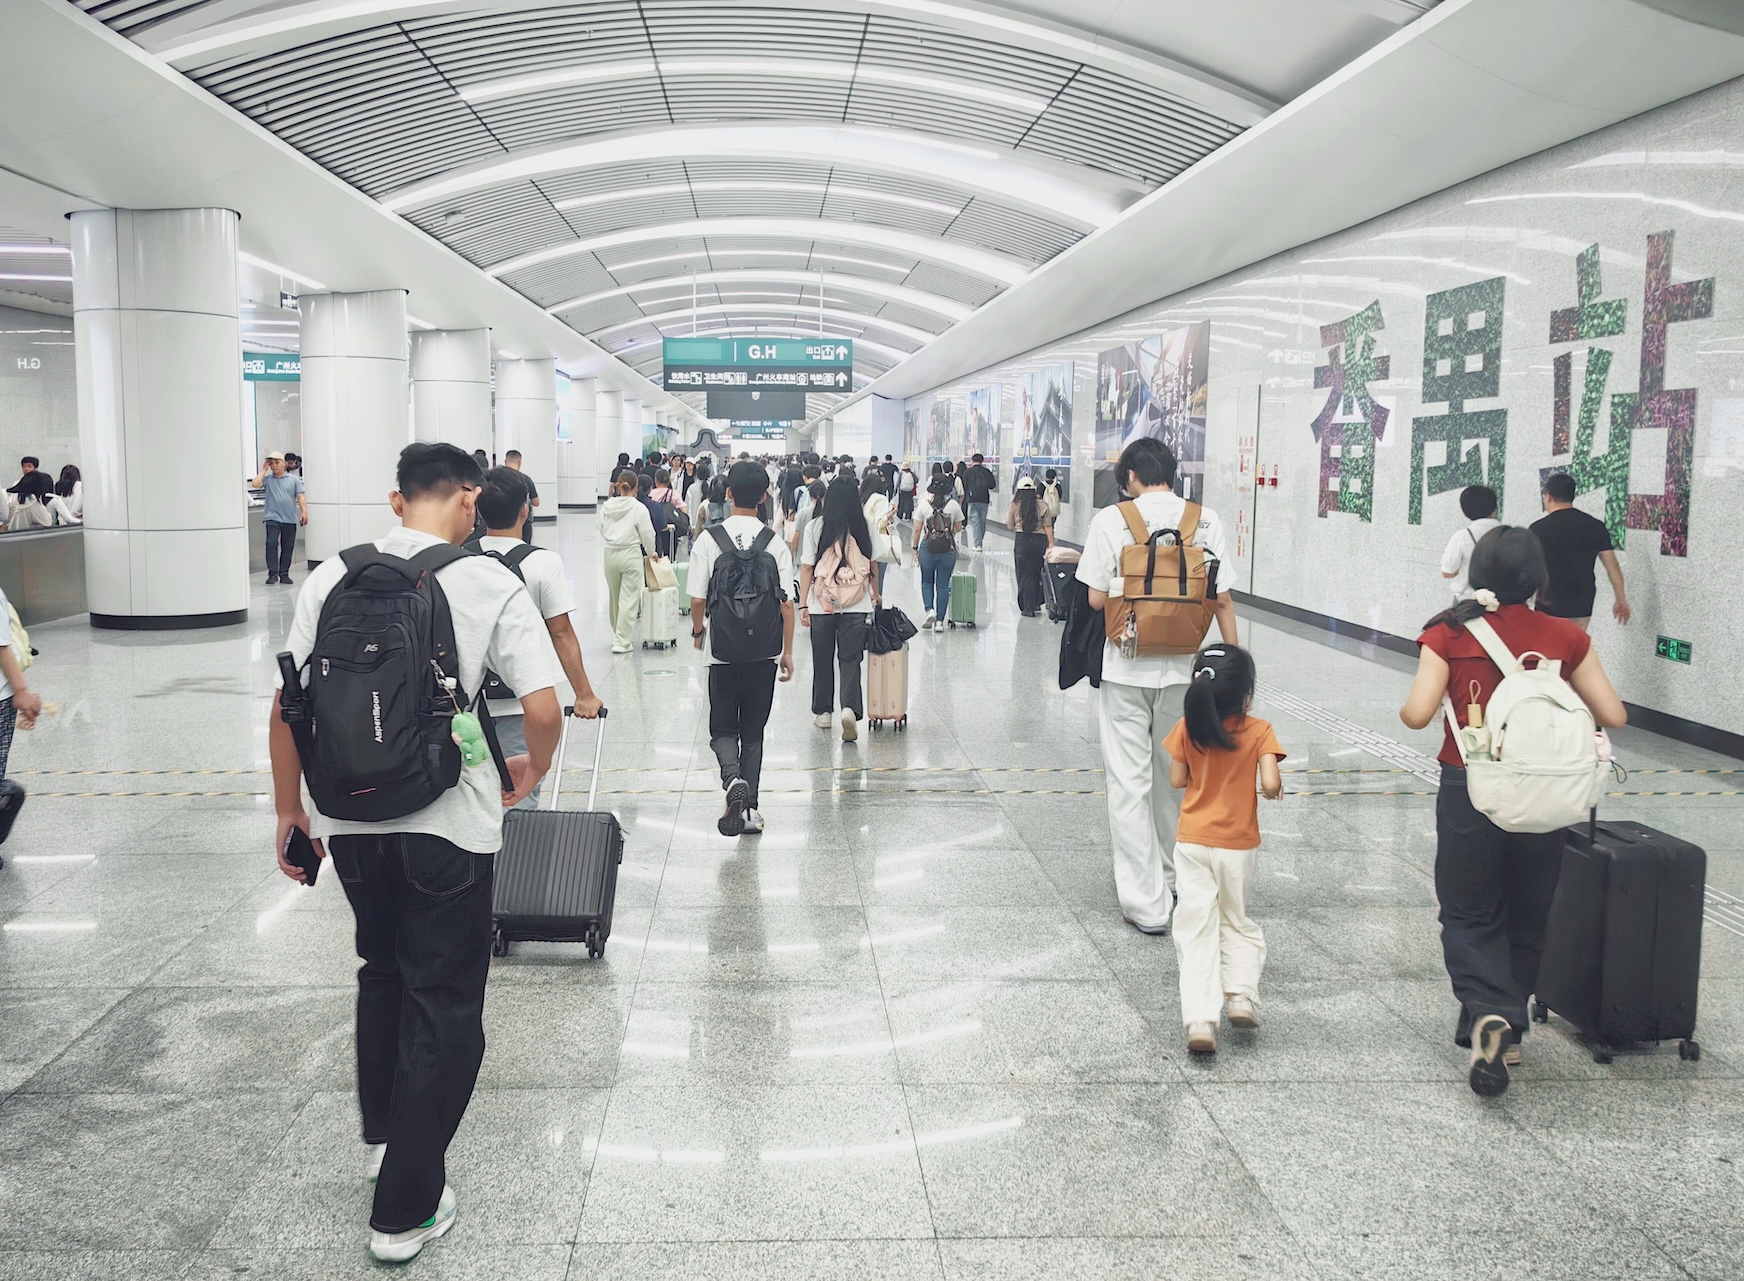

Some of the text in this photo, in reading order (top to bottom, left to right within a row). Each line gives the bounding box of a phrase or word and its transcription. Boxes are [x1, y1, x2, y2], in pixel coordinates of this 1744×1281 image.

[748, 344, 776, 359] G.H
[1311, 230, 1715, 557] 番禺站
